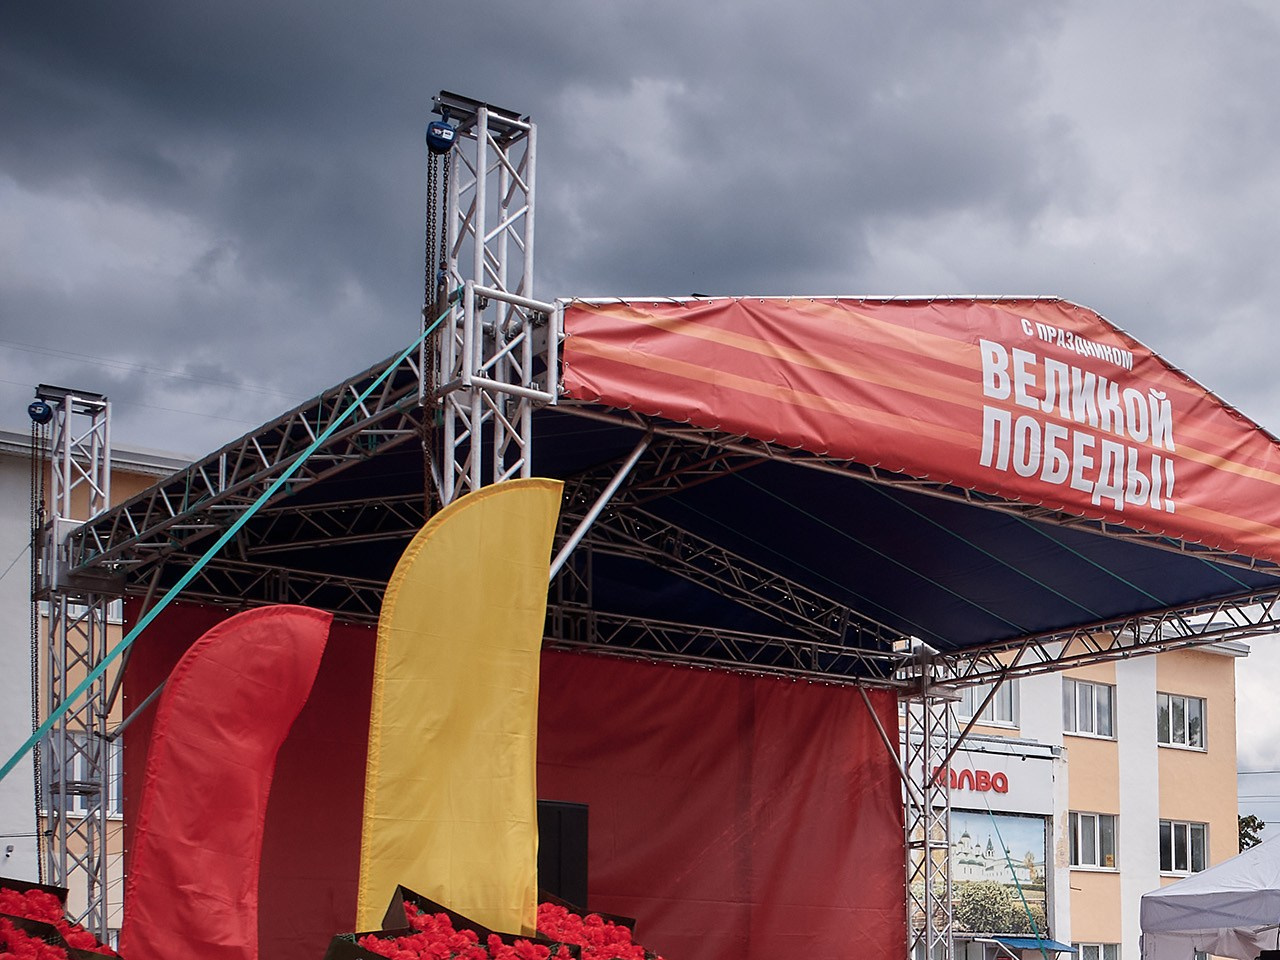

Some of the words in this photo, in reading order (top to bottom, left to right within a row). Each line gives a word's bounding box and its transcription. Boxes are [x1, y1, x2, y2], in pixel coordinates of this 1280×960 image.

[980, 338, 1175, 452] ВЕЛИКОЙ
[1021, 318, 1033, 336] С
[1035, 322, 1133, 371] ПРАЗДНИКОМ
[979, 405, 1175, 513] ПОБЕДЫ!
